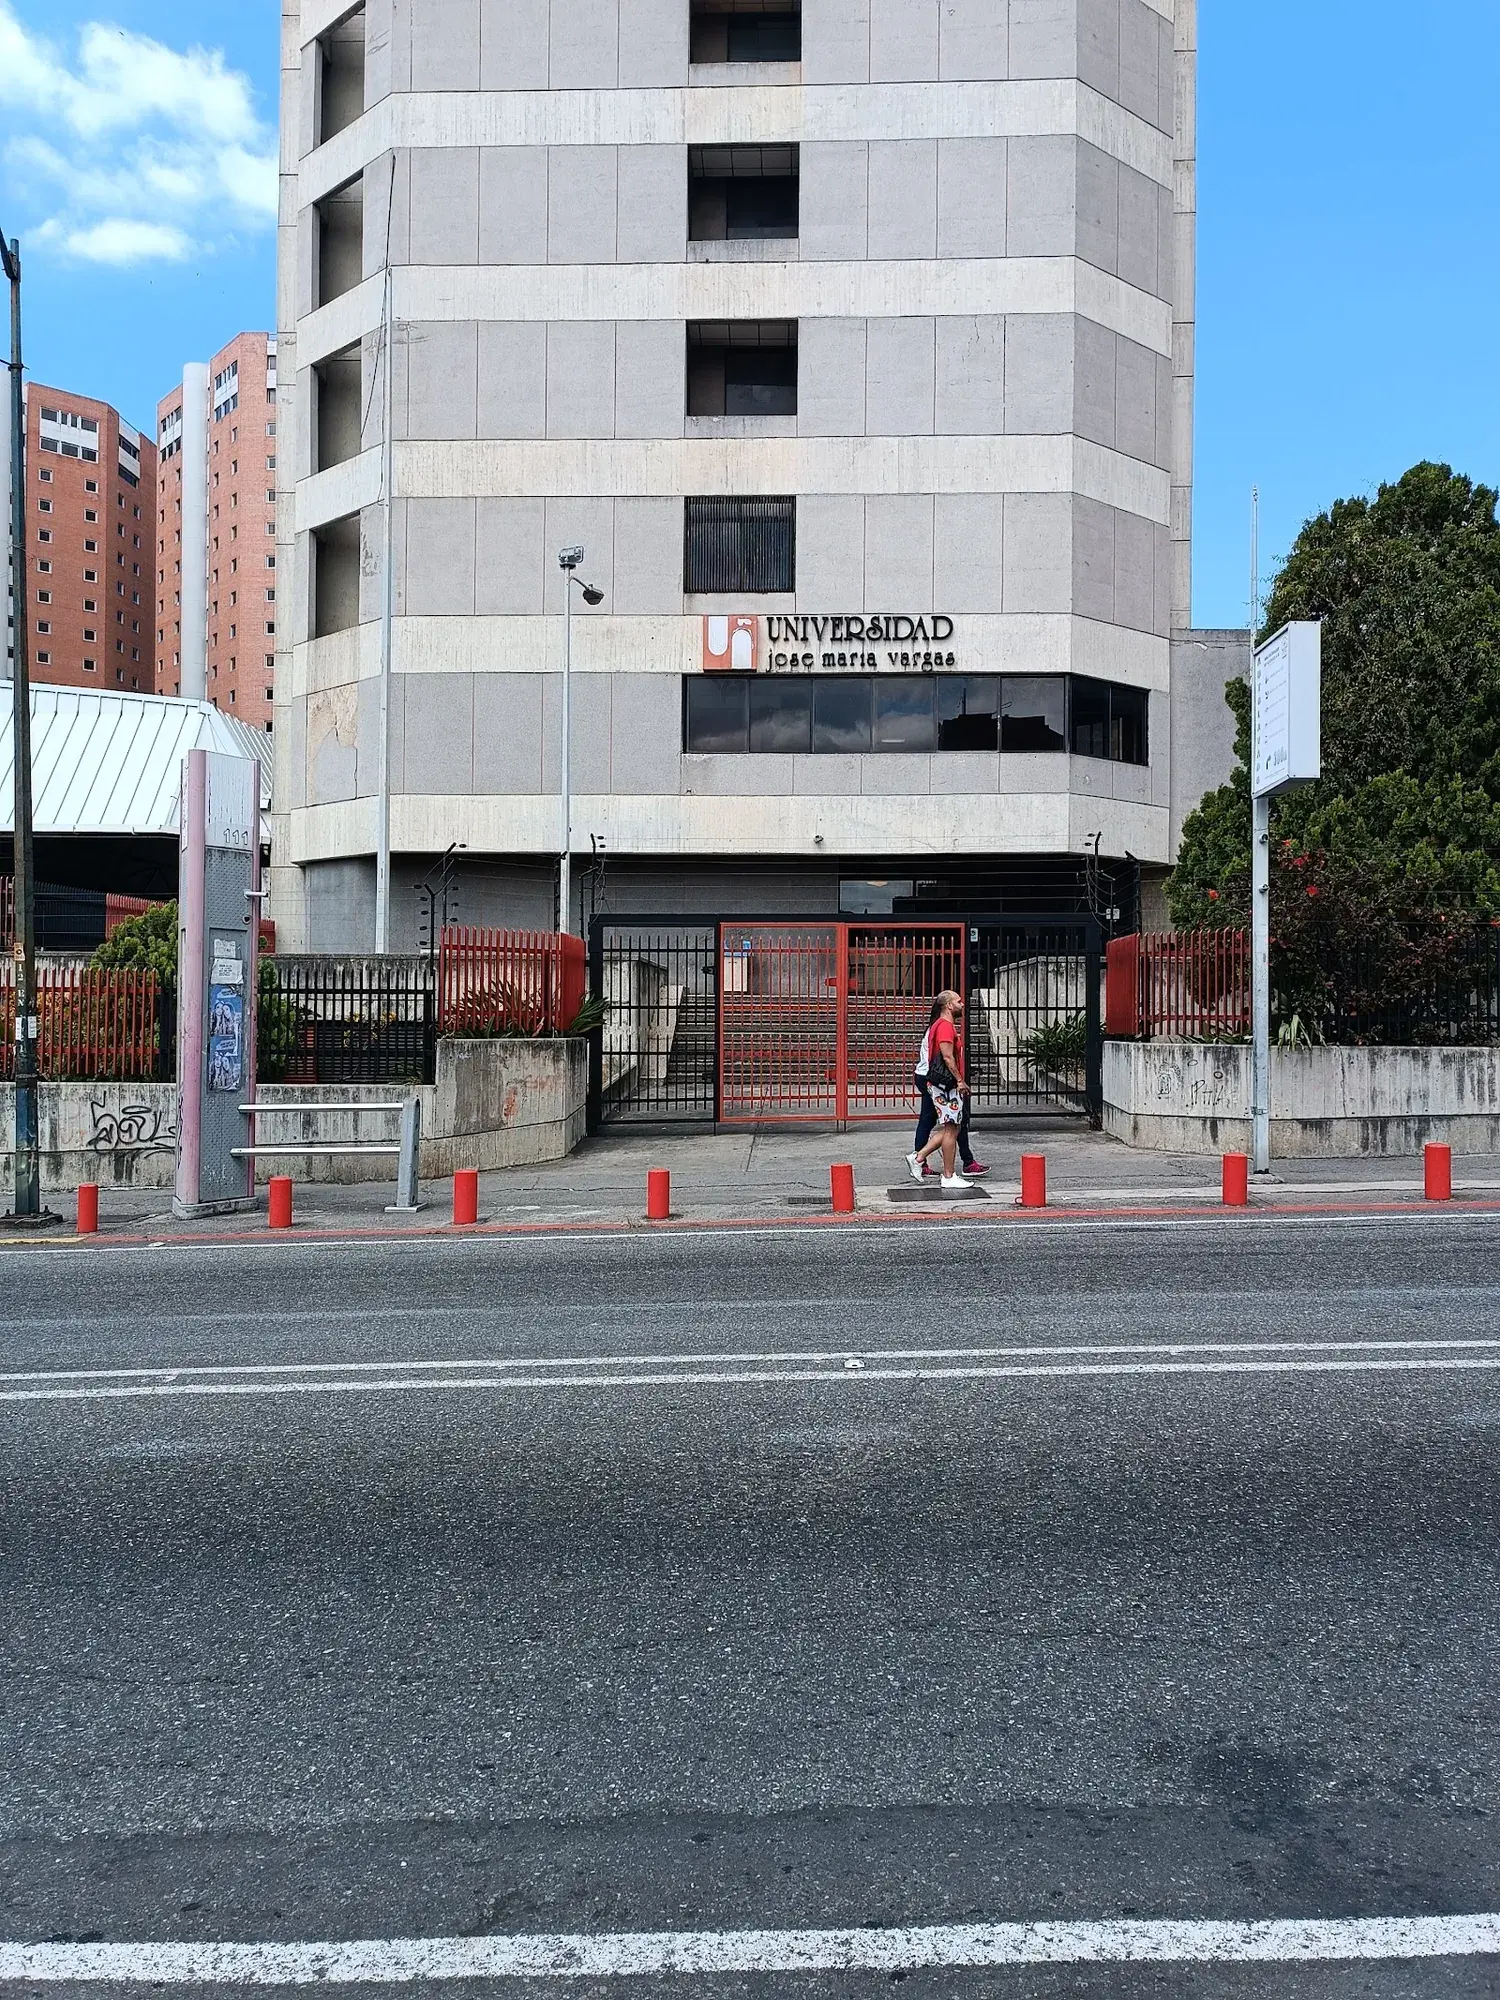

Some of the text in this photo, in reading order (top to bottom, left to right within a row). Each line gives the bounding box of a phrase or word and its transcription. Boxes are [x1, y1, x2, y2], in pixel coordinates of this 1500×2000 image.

[766, 615, 954, 642] UNIVERSIDAD
[765, 648, 815, 672] jose
[887, 651, 956, 673] vargas
[223, 827, 249, 846] 111
